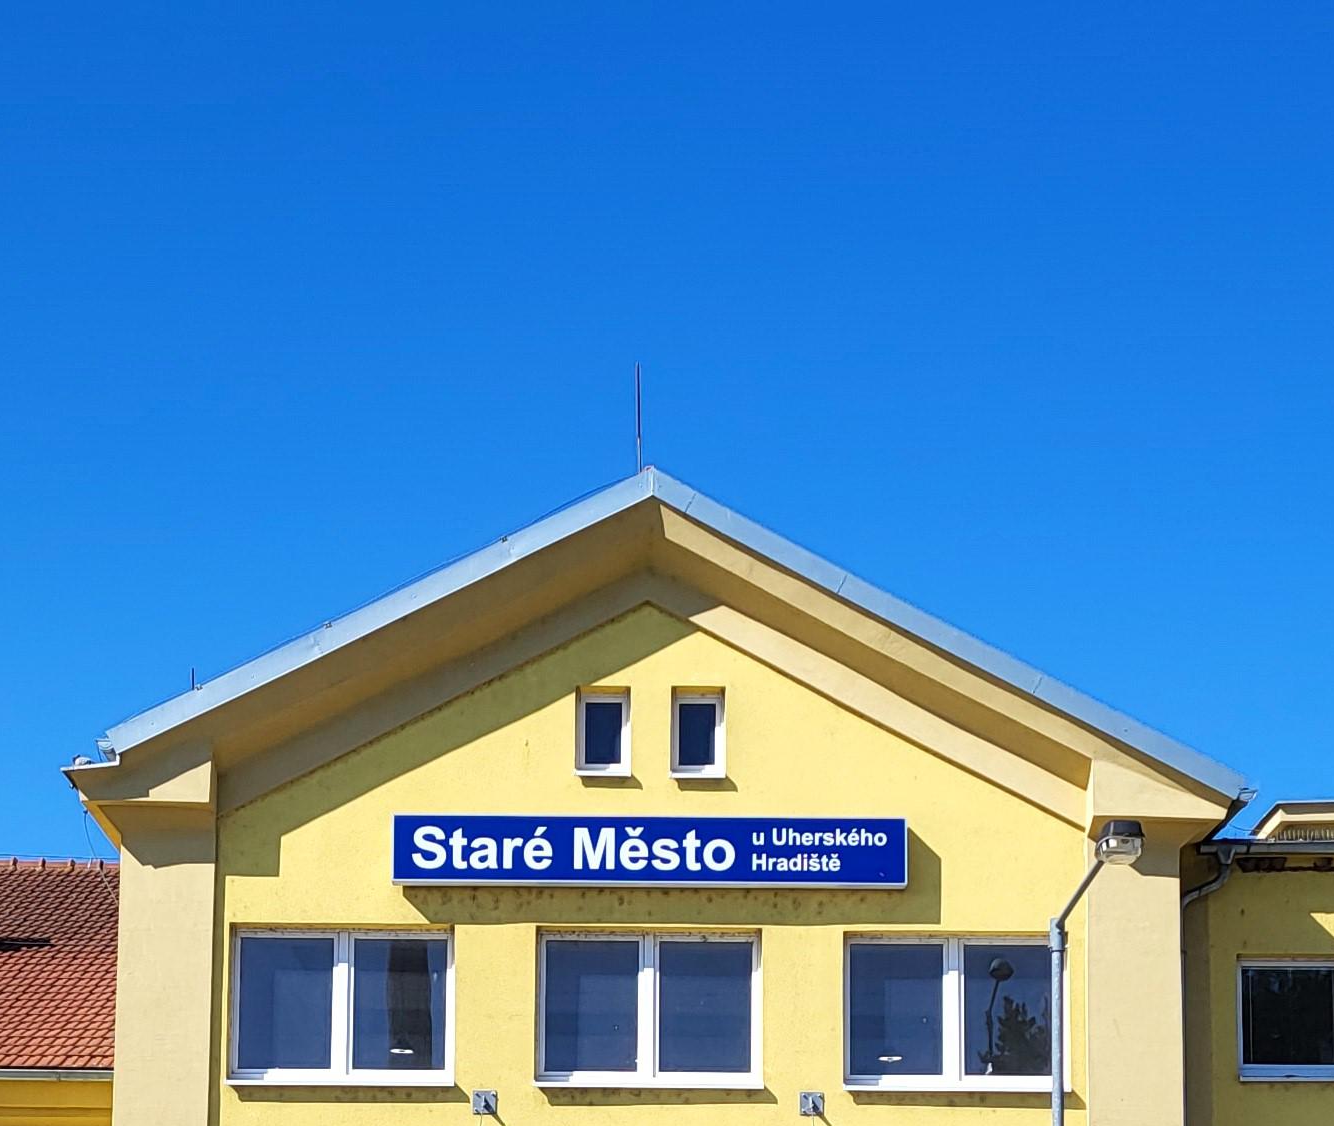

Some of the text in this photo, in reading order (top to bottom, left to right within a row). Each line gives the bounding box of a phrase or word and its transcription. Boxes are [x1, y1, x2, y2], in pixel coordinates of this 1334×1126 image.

[751, 827, 888, 847] u Uherského
[411, 825, 736, 872] Staré Město
[751, 852, 841, 872] Hradiště
